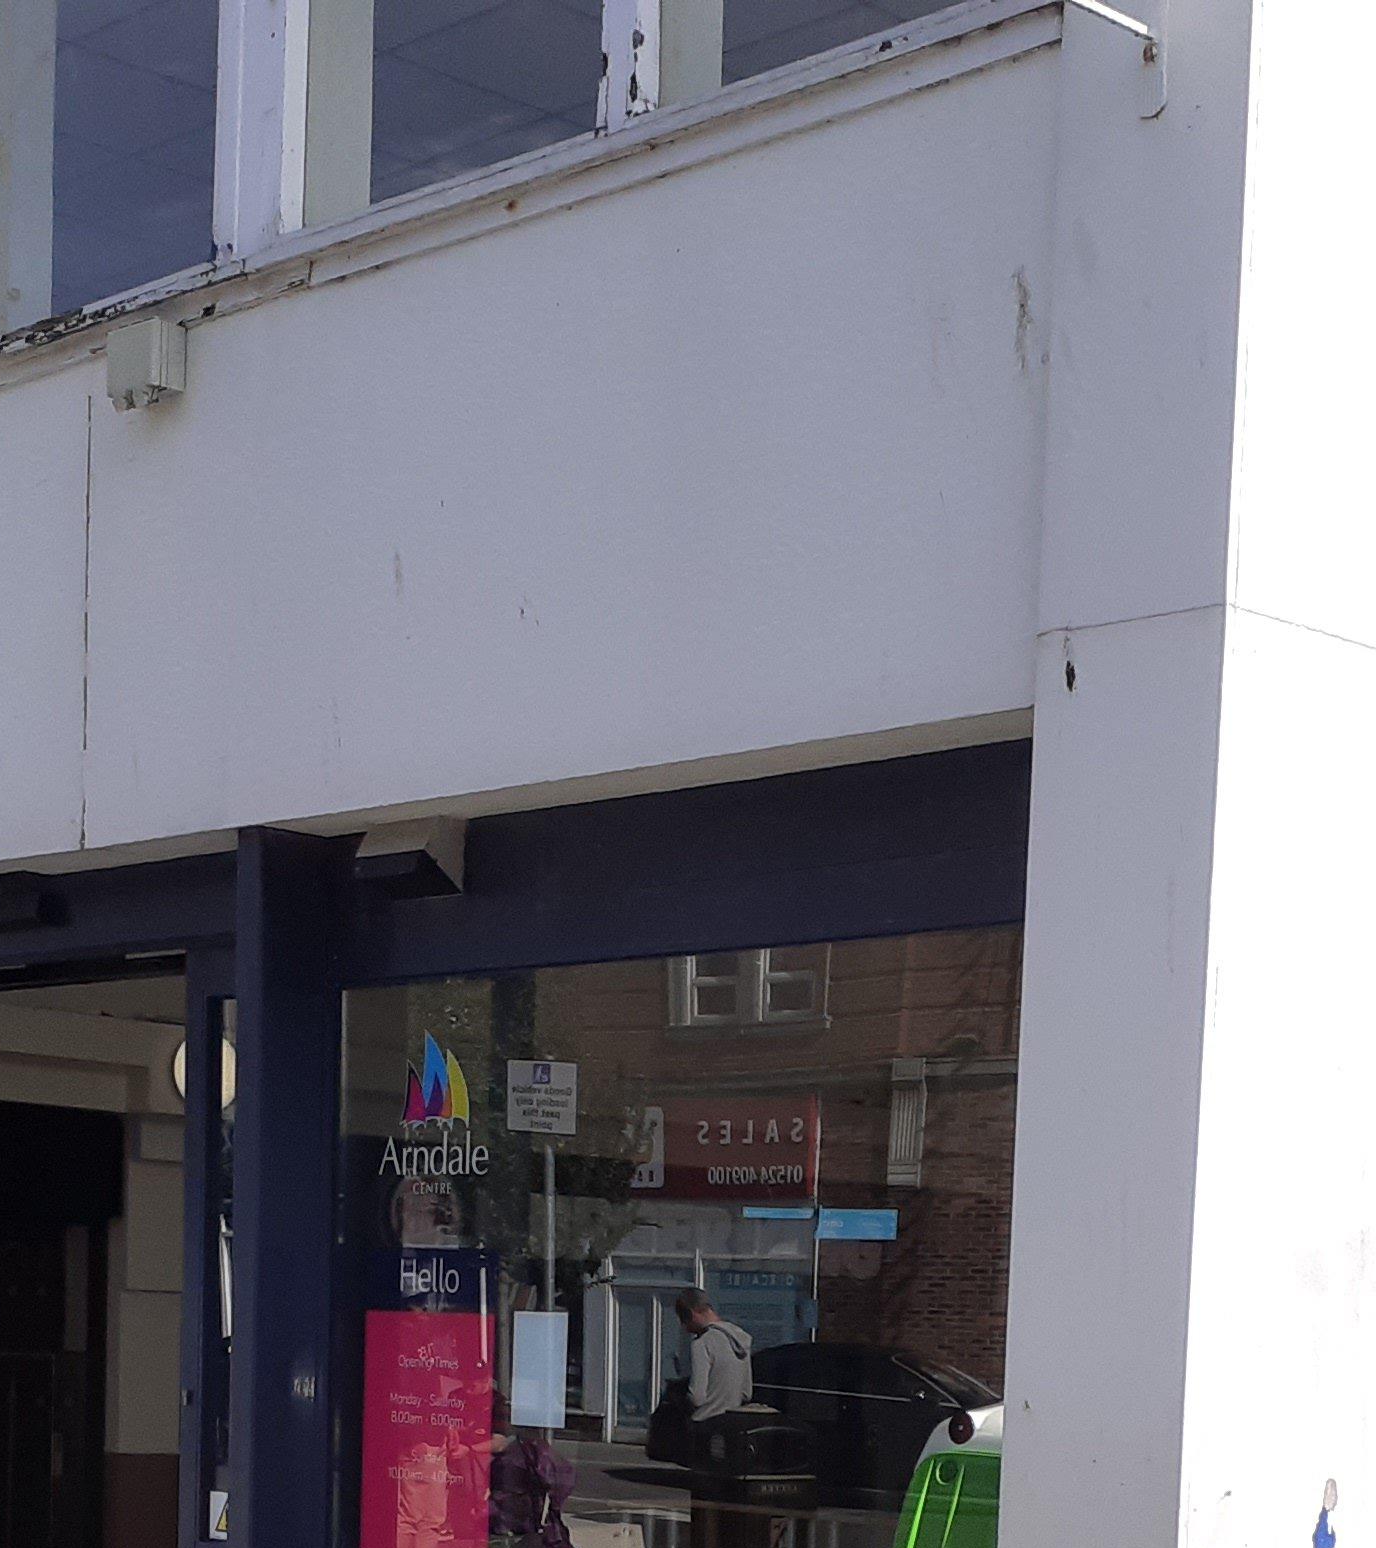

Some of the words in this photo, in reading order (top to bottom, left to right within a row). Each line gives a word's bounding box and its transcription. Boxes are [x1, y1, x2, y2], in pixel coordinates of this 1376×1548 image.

[378, 1130, 490, 1176] Arndale
[412, 1182, 452, 1195] CENTRE
[399, 1257, 461, 1294] Hello
[397, 1354, 435, 1372] Opening
[435, 1357, 460, 1370] Times
[389, 1392, 422, 1408] Monday
[429, 1393, 466, 1411] Saturday
